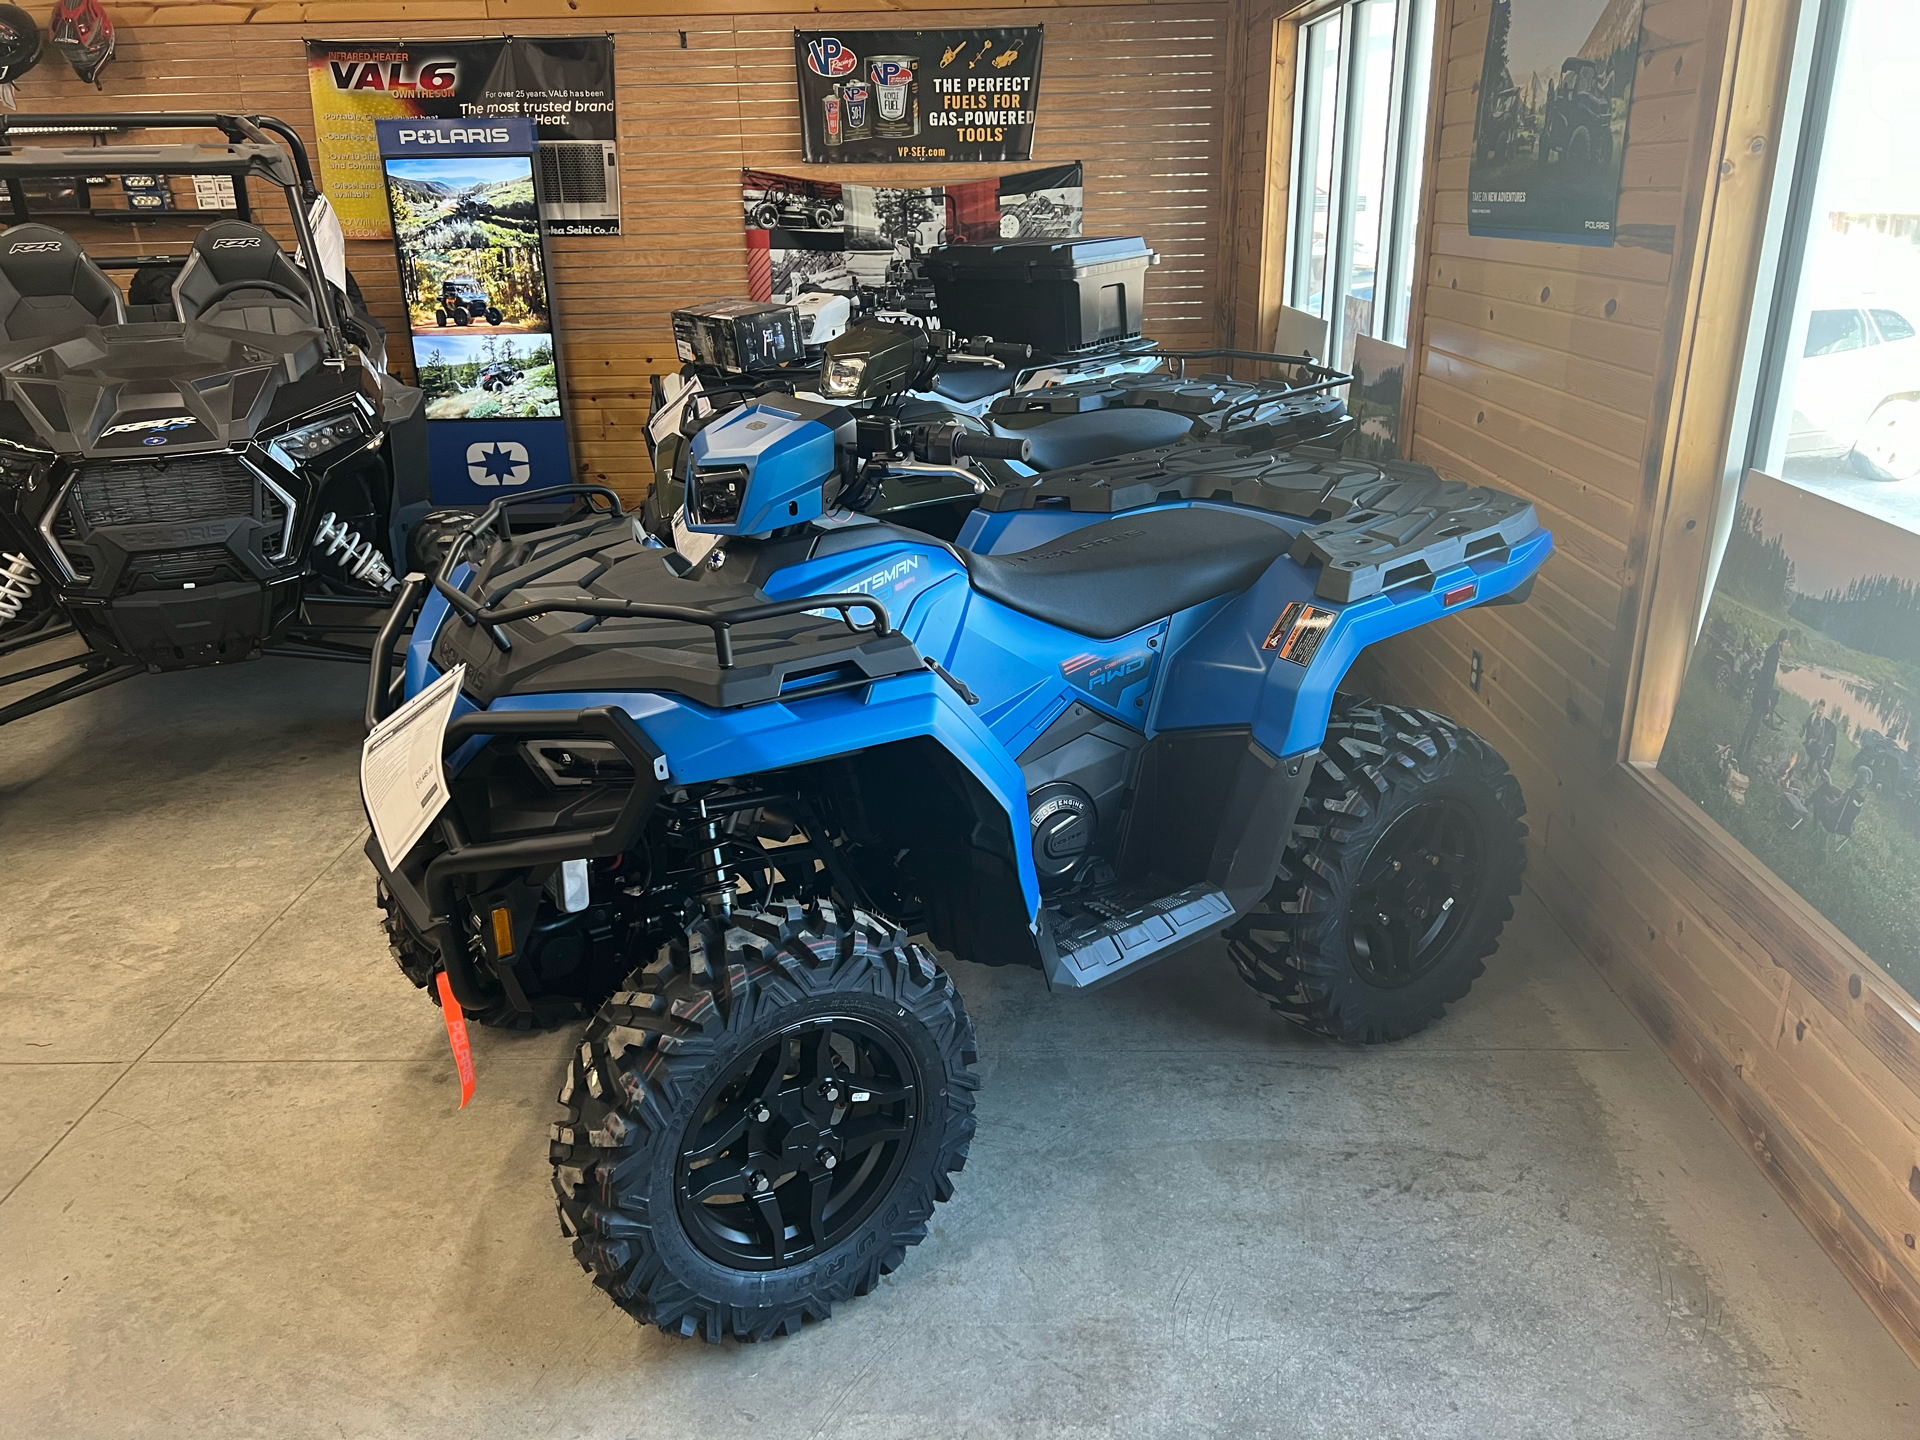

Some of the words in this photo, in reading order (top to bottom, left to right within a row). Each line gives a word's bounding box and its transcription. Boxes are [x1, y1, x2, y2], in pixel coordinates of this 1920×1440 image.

[328, 52, 371, 61] INFRARED
[372, 53, 409, 61] HEATER
[830, 57, 855, 71] Racing
[330, 62, 457, 90] VAL6
[933, 78, 961, 93] THE
[968, 76, 1031, 92] PERFECT
[392, 89, 414, 99] OWN
[416, 89, 436, 98] THE
[526, 91, 548, 99] years,
[459, 103, 484, 114] The
[486, 102, 520, 113] most
[524, 101, 571, 112] trusted
[575, 100, 614, 112] brand
[944, 94, 987, 109] FUELS
[993, 94, 1020, 108] FOR
[535, 114, 570, 125] Heat.
[929, 110, 1034, 126] GAS-POWERED
[398, 127, 510, 145] POLARIS
[897, 146, 946, 157] VP-SEF.com
[1488, 191, 1498, 202] NEW
[1498, 192, 1526, 203] ADVENTURES
[566, 225, 592, 235] Seiki
[1584, 220, 1610, 230] POLARIS
[9, 241, 62, 254] RZR
[213, 237, 261, 249] RZR
[121, 524, 228, 546] POLARIS
[1016, 528, 1148, 562] POLARIS
[1089, 658, 1145, 691] AWD
[1058, 799, 1084, 811] ENGINE
[449, 1020, 475, 1086] POLARIS
